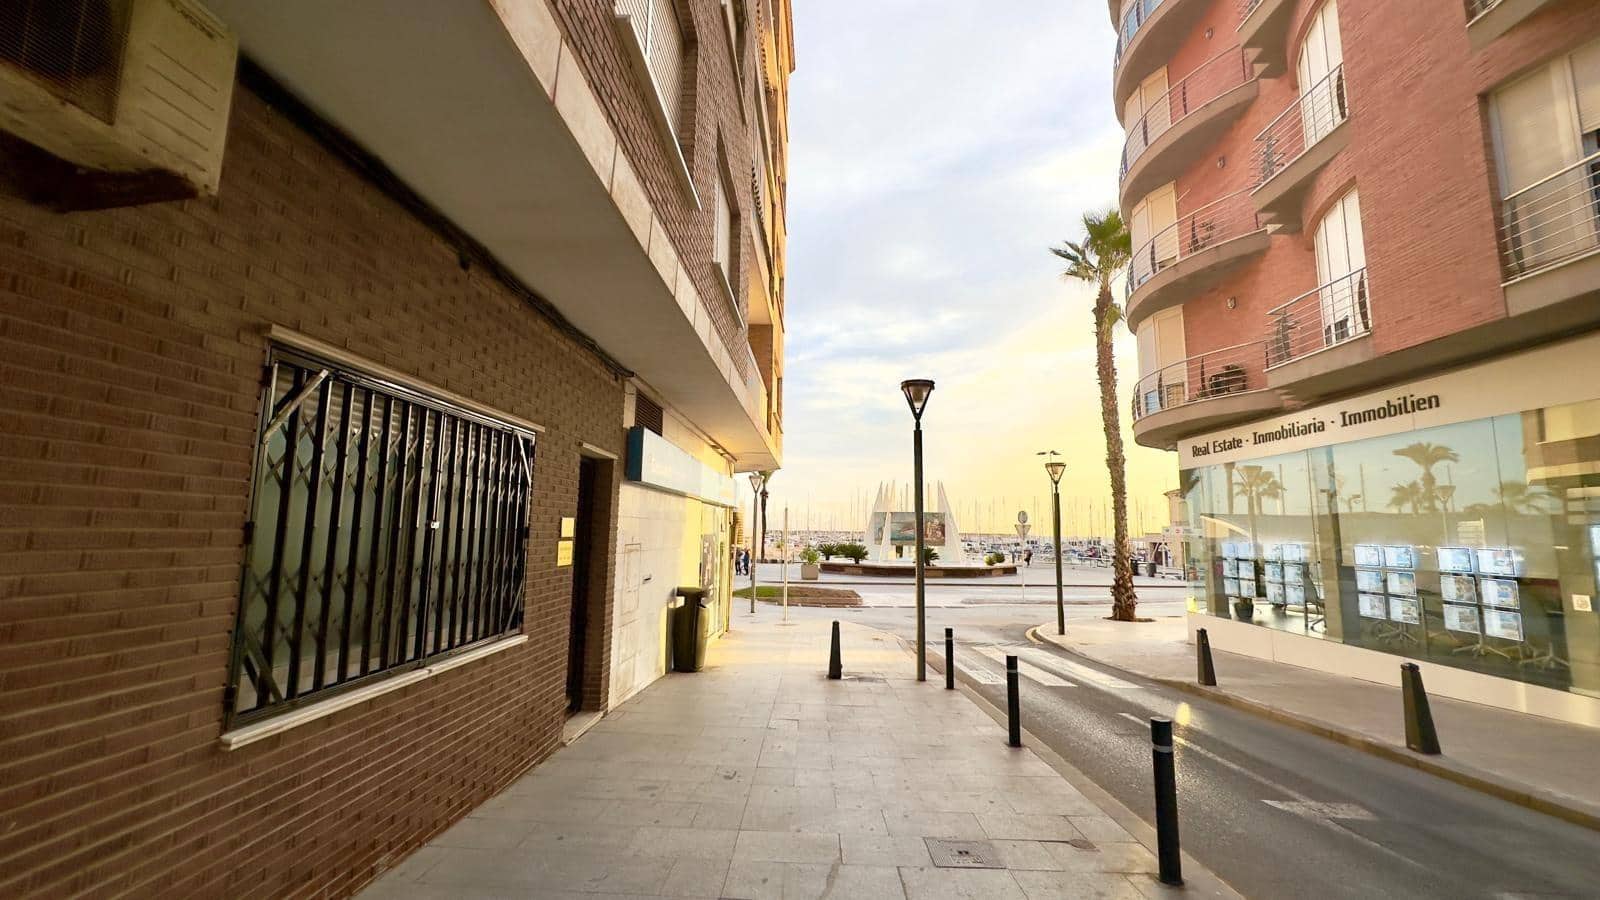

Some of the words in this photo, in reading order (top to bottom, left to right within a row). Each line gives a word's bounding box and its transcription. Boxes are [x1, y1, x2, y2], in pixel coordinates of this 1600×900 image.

[1191, 439, 1211, 458] Real
[1212, 436, 1243, 455] Estate
[1252, 418, 1326, 445] Inmobiliaria
[1340, 394, 1441, 428] Immobilien
